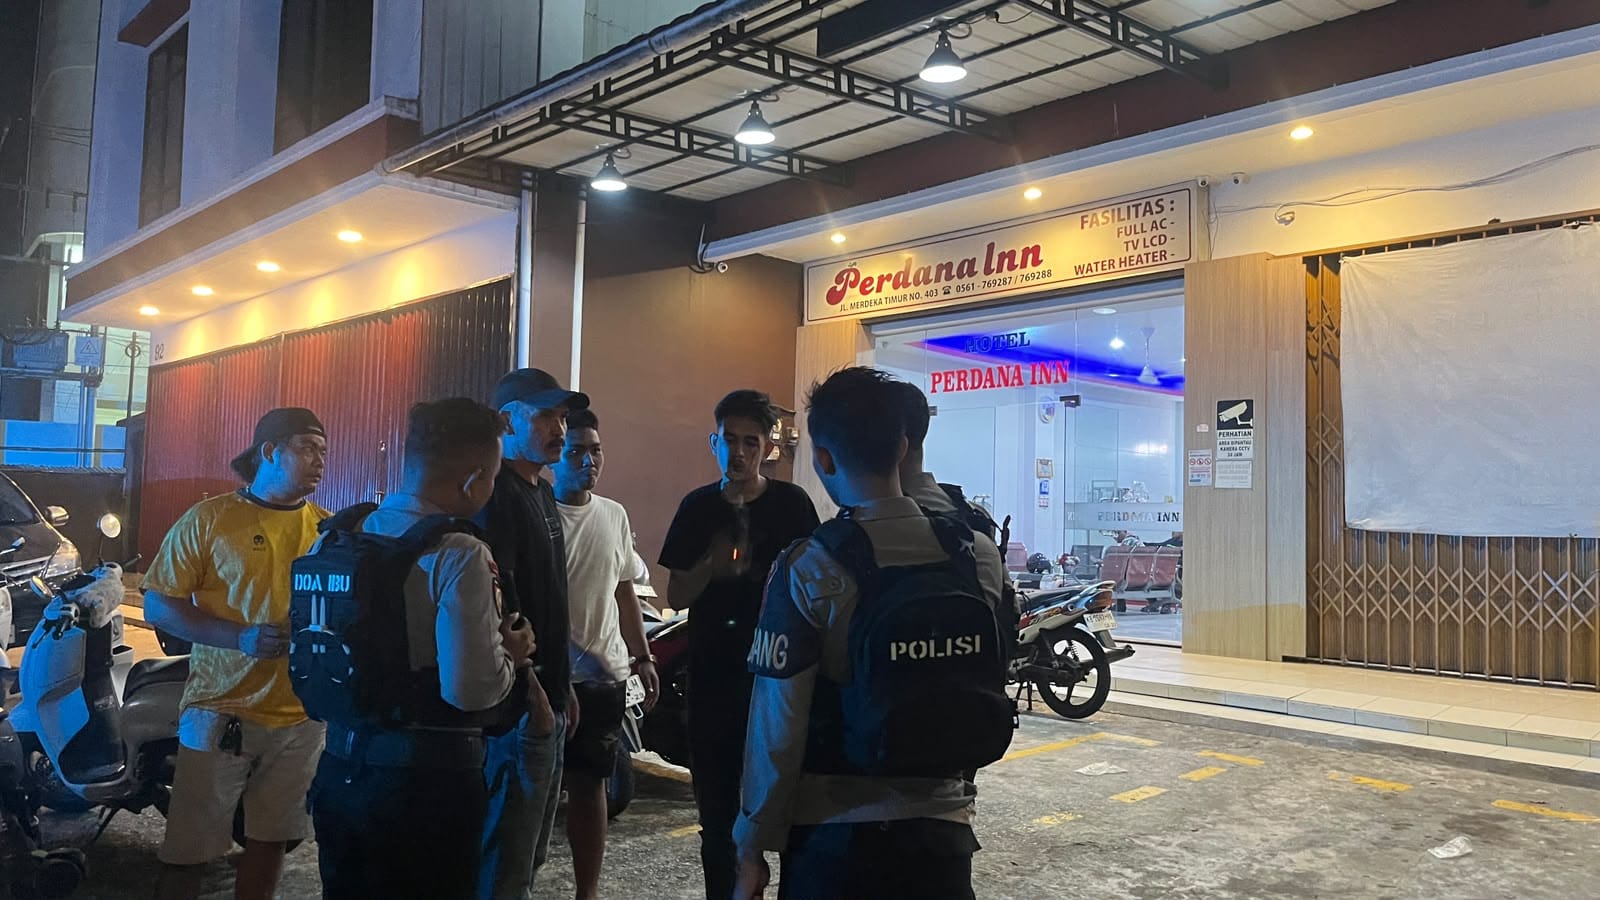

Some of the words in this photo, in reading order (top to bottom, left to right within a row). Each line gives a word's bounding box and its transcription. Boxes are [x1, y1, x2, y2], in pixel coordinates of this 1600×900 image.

[1081, 199, 1165, 230] FASILITAS
[1117, 223, 1147, 238] FULL
[1150, 218, 1167, 232] AC
[1124, 239, 1139, 252] TV
[1143, 234, 1167, 248] LCD
[826, 257, 978, 305] Perdana
[983, 242, 1043, 276] Inn
[1074, 259, 1115, 276] WATER
[1119, 250, 1167, 268] HEATER
[840, 303, 849, 312] JL.
[850, 298, 883, 310] MERDEKA
[885, 295, 908, 305] TIMUR
[909, 292, 922, 301] NO.
[925, 289, 938, 298] 403
[956, 283, 975, 293] 0561
[982, 276, 1012, 289] 769287
[1020, 269, 1052, 283] 769288
[965, 332, 1030, 353] HOTEL
[931, 364, 1024, 393] PERDANA
[1030, 360, 1070, 385] INN
[1157, 511, 1179, 522] INN
[294, 574, 323, 591] DOA
[328, 574, 350, 592] IBU
[747, 627, 789, 670] ANG
[890, 634, 981, 661] POLISI
